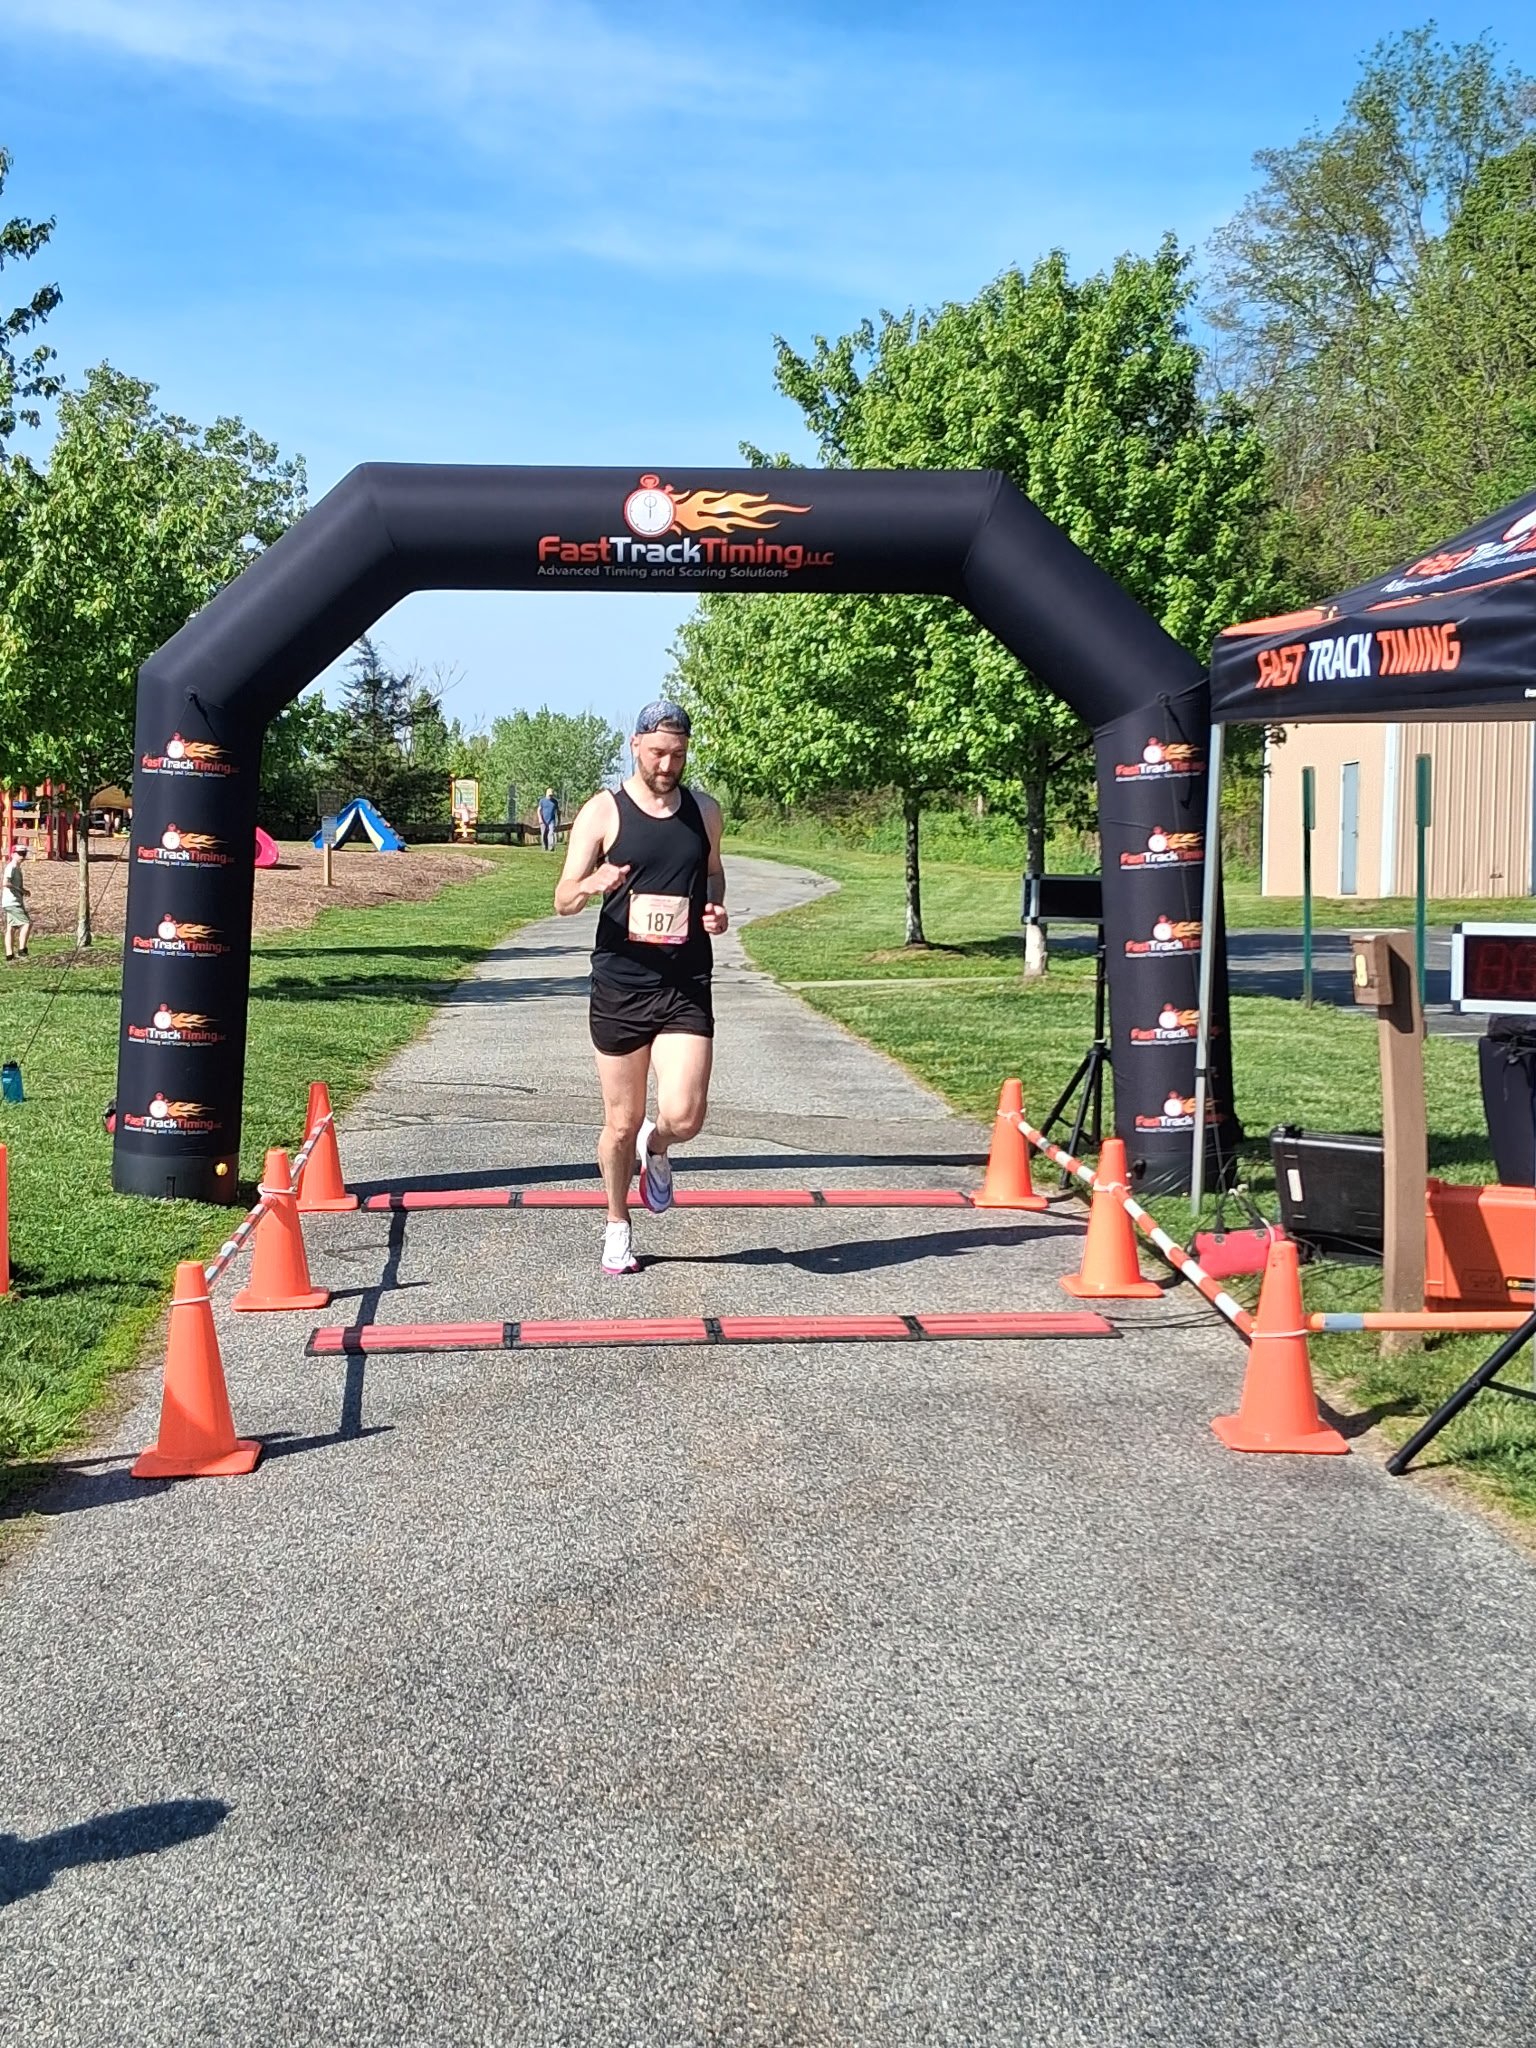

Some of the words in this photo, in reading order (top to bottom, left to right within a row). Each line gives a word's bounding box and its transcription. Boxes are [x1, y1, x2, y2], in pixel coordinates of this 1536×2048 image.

[537, 565, 600, 576] Advanced
[603, 566, 648, 579] Timing
[651, 566, 676, 577] and
[679, 566, 726, 579] Scoring
[730, 566, 789, 578] Solutions
[1255, 644, 1306, 688] FAST
[1308, 632, 1373, 682] TRACK
[1376, 622, 1461, 675] TIMING
[646, 911, 675, 932] 187
